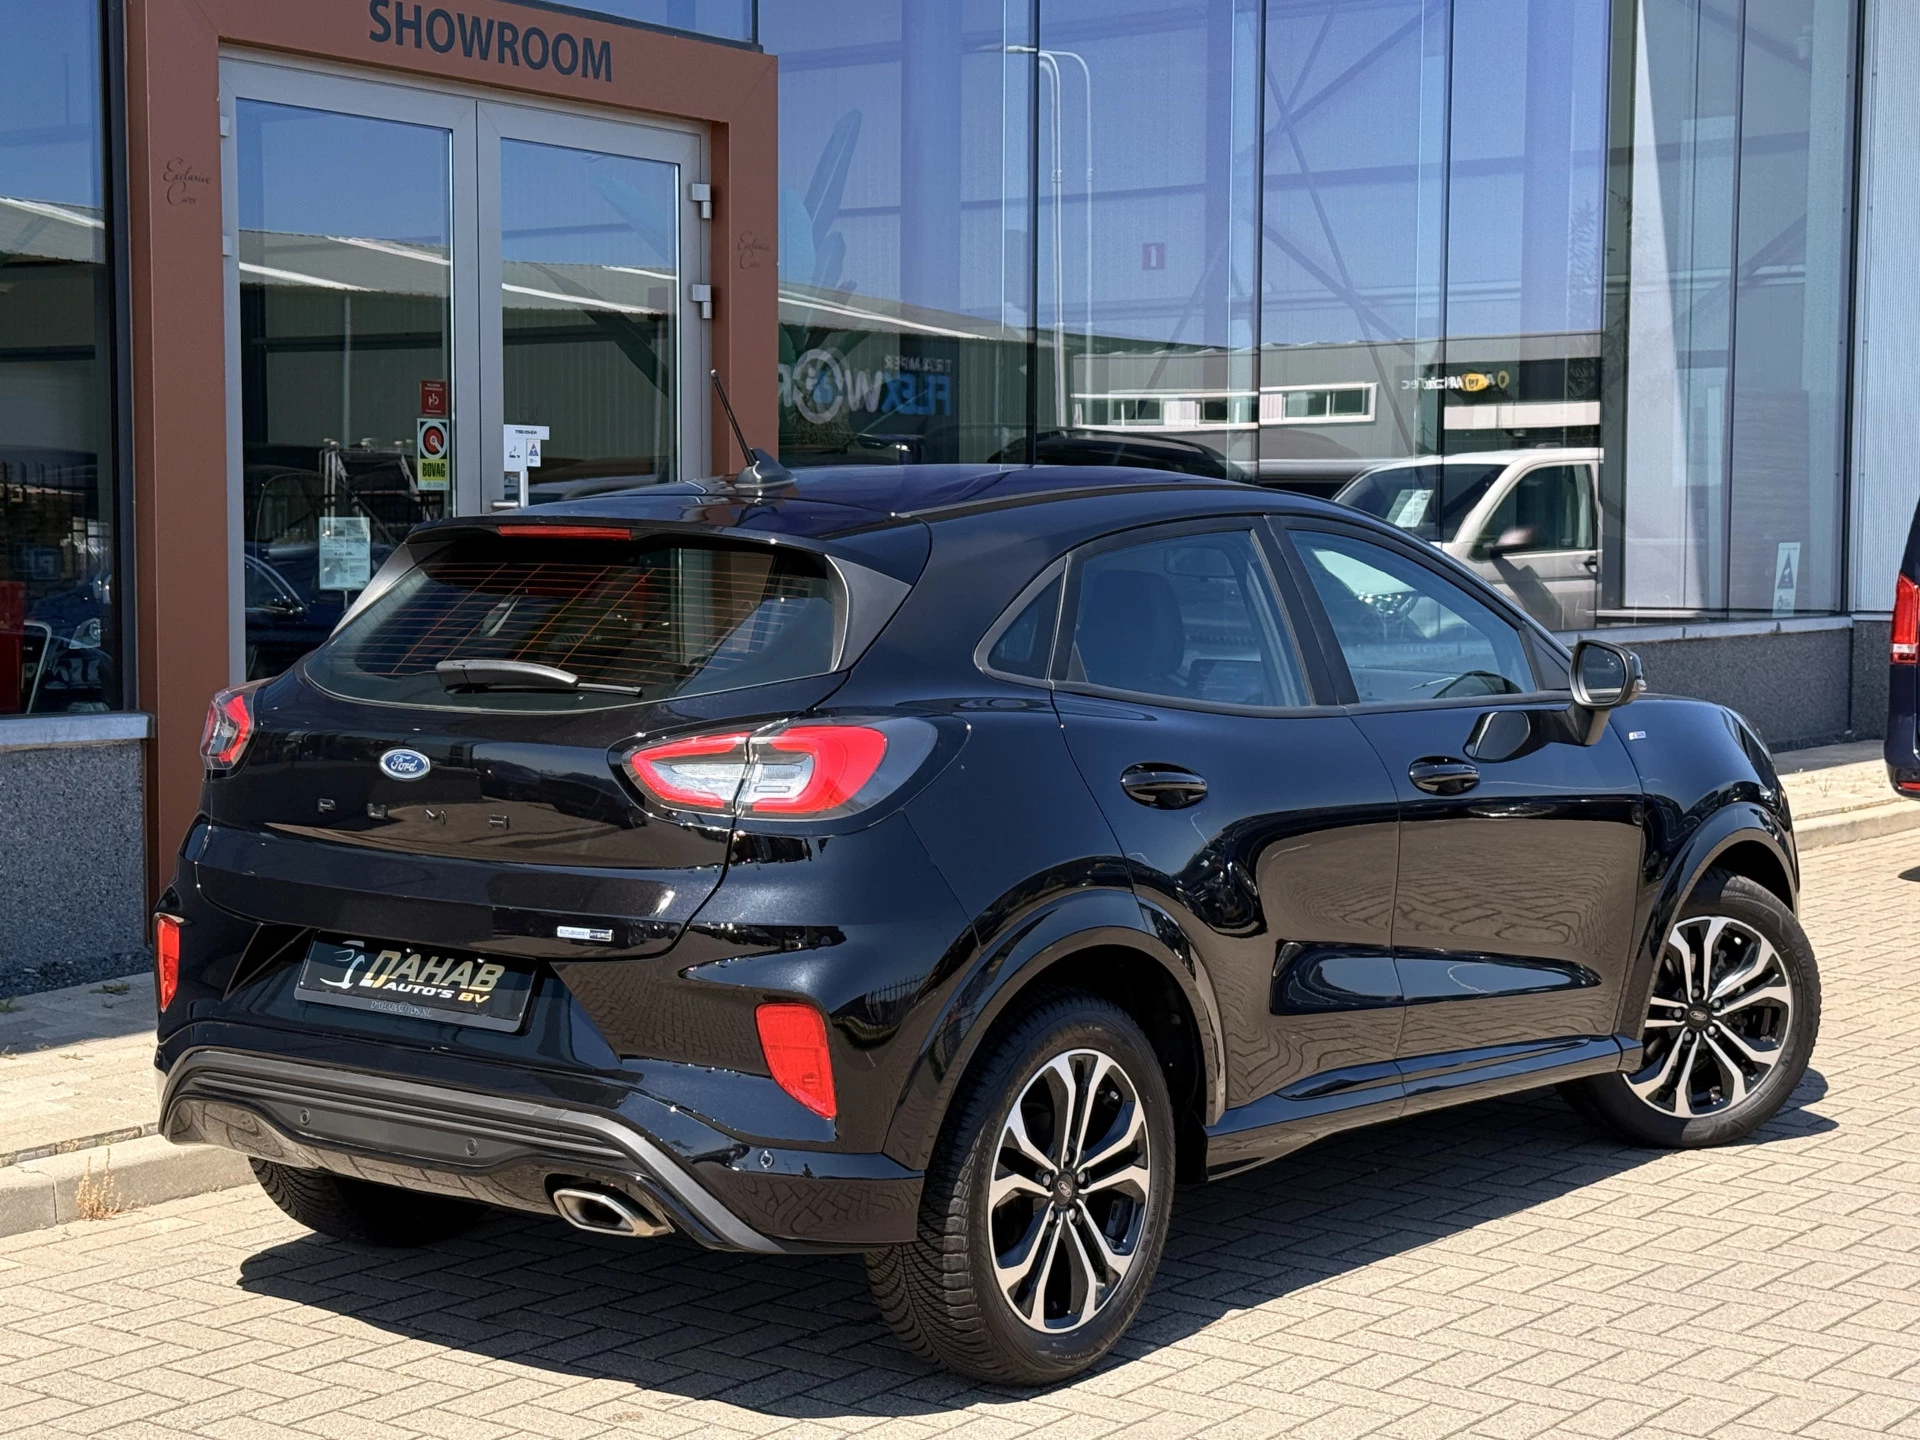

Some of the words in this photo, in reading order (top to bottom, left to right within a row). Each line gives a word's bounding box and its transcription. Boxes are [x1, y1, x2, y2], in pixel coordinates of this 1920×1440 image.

[369, 0, 612, 82] SHOWROOM
[422, 462, 446, 477] BOVAG
[390, 753, 419, 772] Ford
[317, 798, 511, 830] PUMA
[360, 950, 505, 992] DAHAB
[382, 981, 455, 999] AUTO'S
[457, 991, 490, 1004] BV
